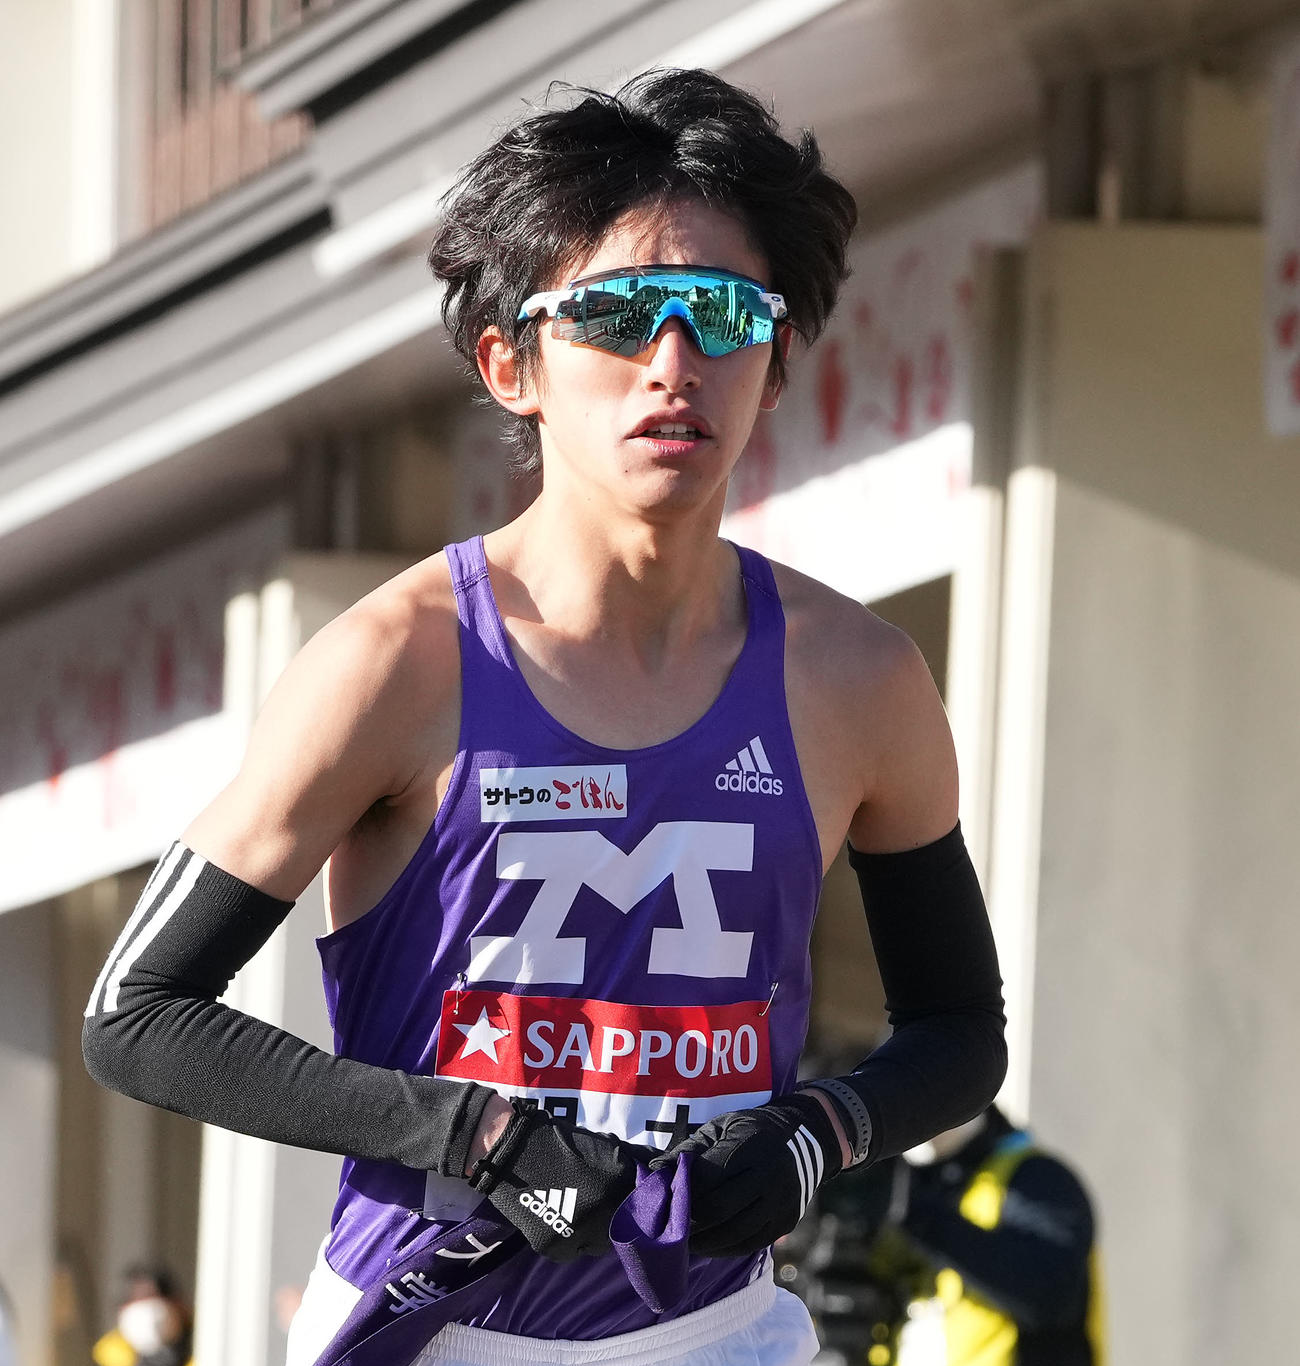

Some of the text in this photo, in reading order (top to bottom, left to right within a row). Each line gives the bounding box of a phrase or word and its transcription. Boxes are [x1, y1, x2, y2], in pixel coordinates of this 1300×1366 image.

[483, 772, 624, 811] サトウのごはん
[715, 770, 784, 796] adidas
[470, 820, 755, 985] M
[524, 1019, 758, 1079] SAPPORO
[519, 1192, 574, 1238] adidas
